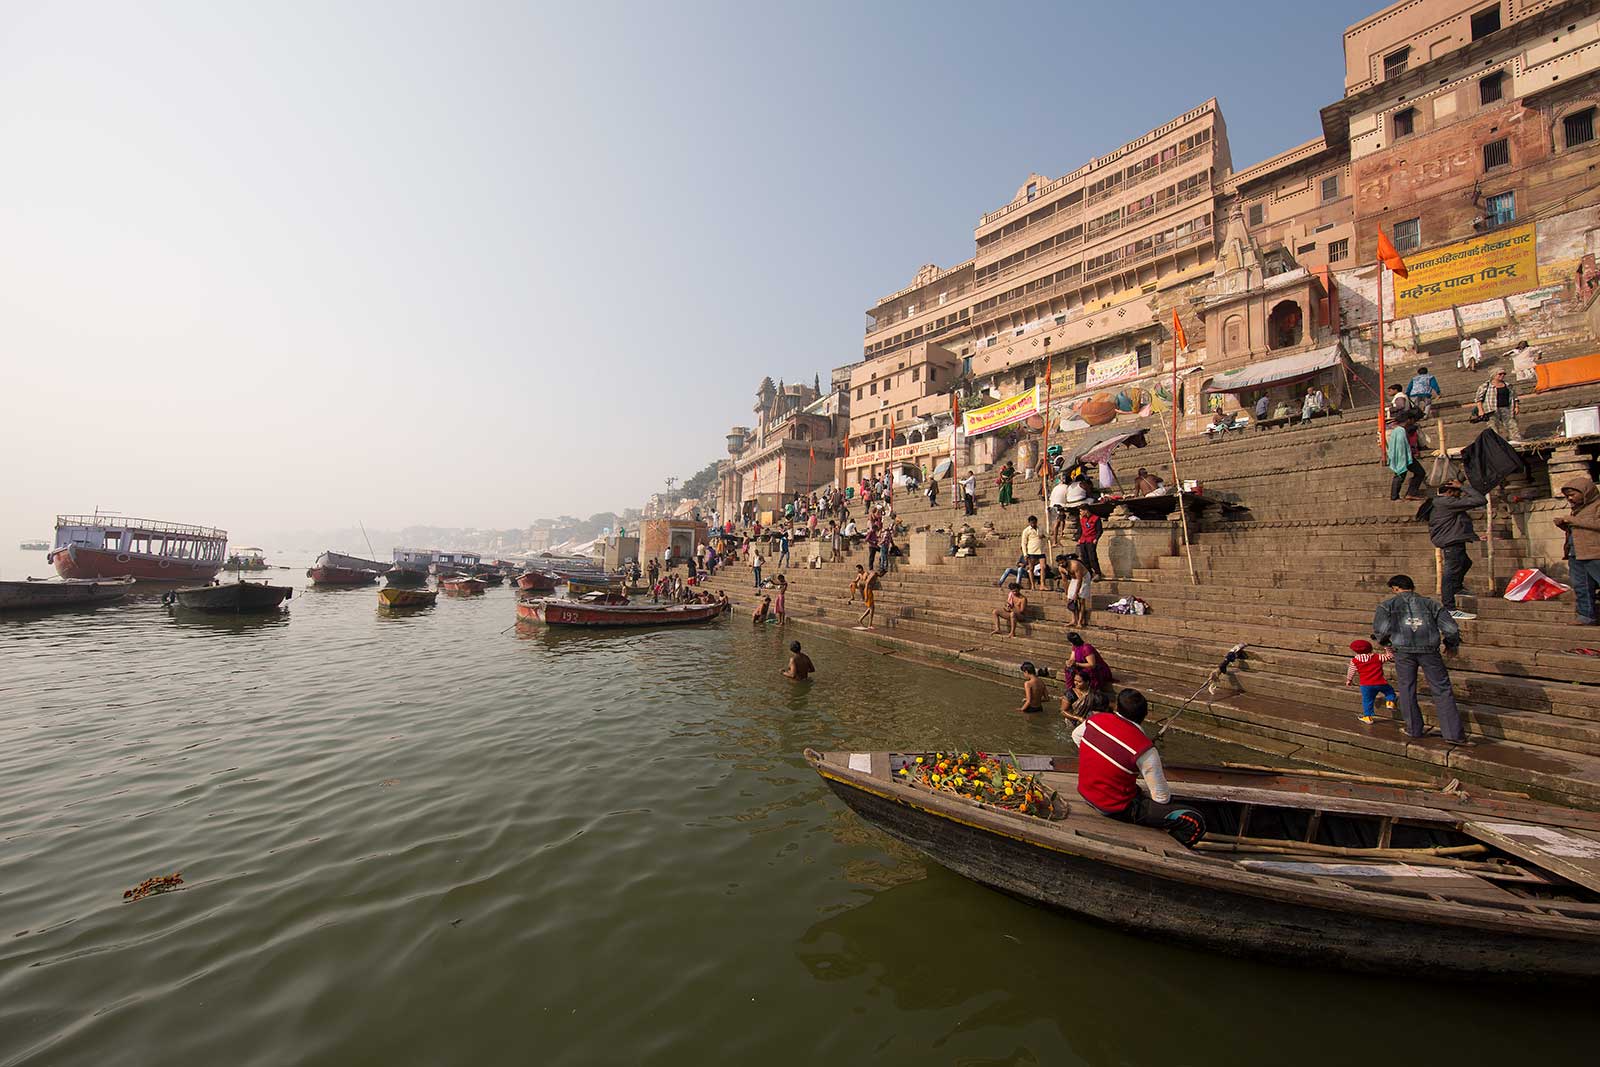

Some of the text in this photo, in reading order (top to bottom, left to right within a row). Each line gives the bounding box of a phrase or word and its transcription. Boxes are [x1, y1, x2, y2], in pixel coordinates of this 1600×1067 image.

[1513, 233, 1531, 245] घाट
[1443, 273, 1475, 288] पाल
[878, 450, 890, 461] SILK
[892, 444, 920, 458] ACTORY
[563, 611, 578, 624] 193
